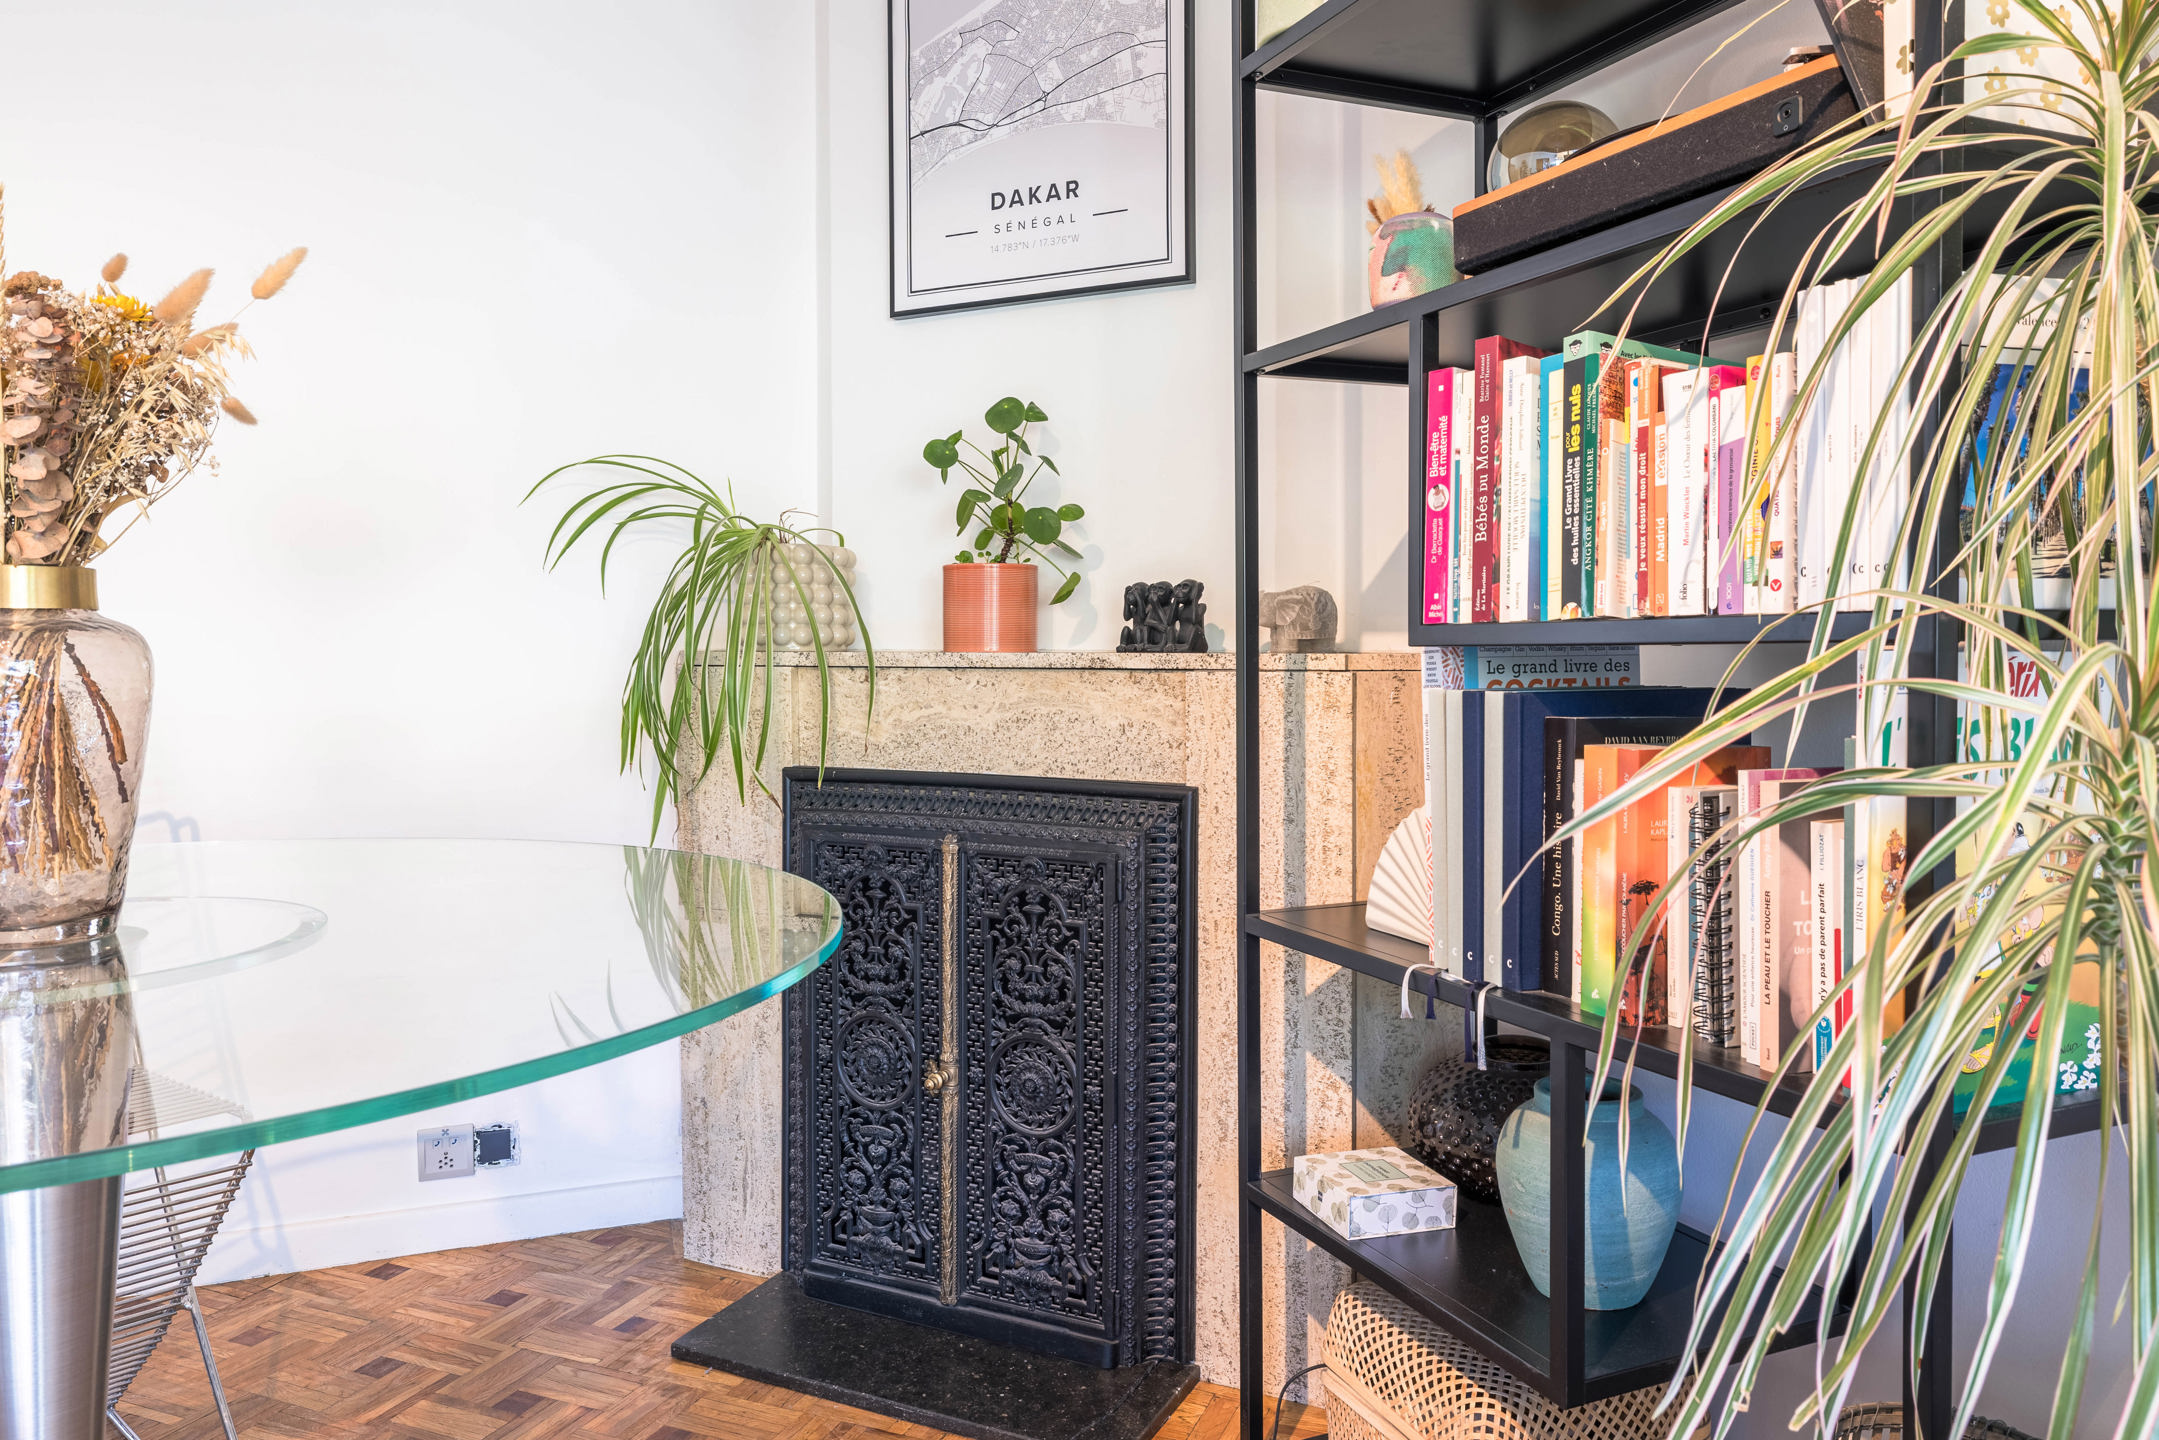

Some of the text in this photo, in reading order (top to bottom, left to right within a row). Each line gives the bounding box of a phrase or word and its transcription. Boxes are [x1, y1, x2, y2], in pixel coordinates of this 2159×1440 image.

[991, 180, 1080, 211] DAKAR
[994, 213, 1076, 234] SÉNÉGAL
[1040, 233, 1080, 249] 17.376°W
[1567, 383, 1582, 453] les nuls
[1429, 431, 1440, 478] Bien-être
[1438, 415, 1449, 477] et maternité
[1476, 415, 1490, 470] Monde
[1638, 452, 1647, 476] droit
[1564, 458, 1573, 529] Le Grand Livre
[1583, 447, 1594, 571] ANGKOR CITÉ KHMÈRE
[1474, 496, 1488, 543] Bébés
[1570, 456, 1581, 566] des huiles essentielles
[1638, 502, 1646, 534] réussir
[1655, 517, 1666, 562] Madrid
[1682, 521, 1690, 546] Martin
[1430, 555, 1438, 564] Dr
[1436, 546, 1443, 556] de
[1678, 583, 1688, 600] folio
[1486, 657, 1631, 679] Le grand livre des
[1551, 811, 1564, 937] Congo. Une hisire
[1855, 859, 1865, 898] BLANC
[1764, 890, 1772, 935] TOUCHER
[1817, 882, 1827, 914] parfait
[1764, 937, 1771, 950] LE
[1818, 916, 1827, 947] parent
[1467, 951, 1473, 961] C
[1507, 958, 1512, 968] C
[1764, 950, 1771, 964] ET
[1818, 949, 1826, 957] de
[1819, 958, 1827, 978] pas
[1764, 993, 1771, 1006] LA
